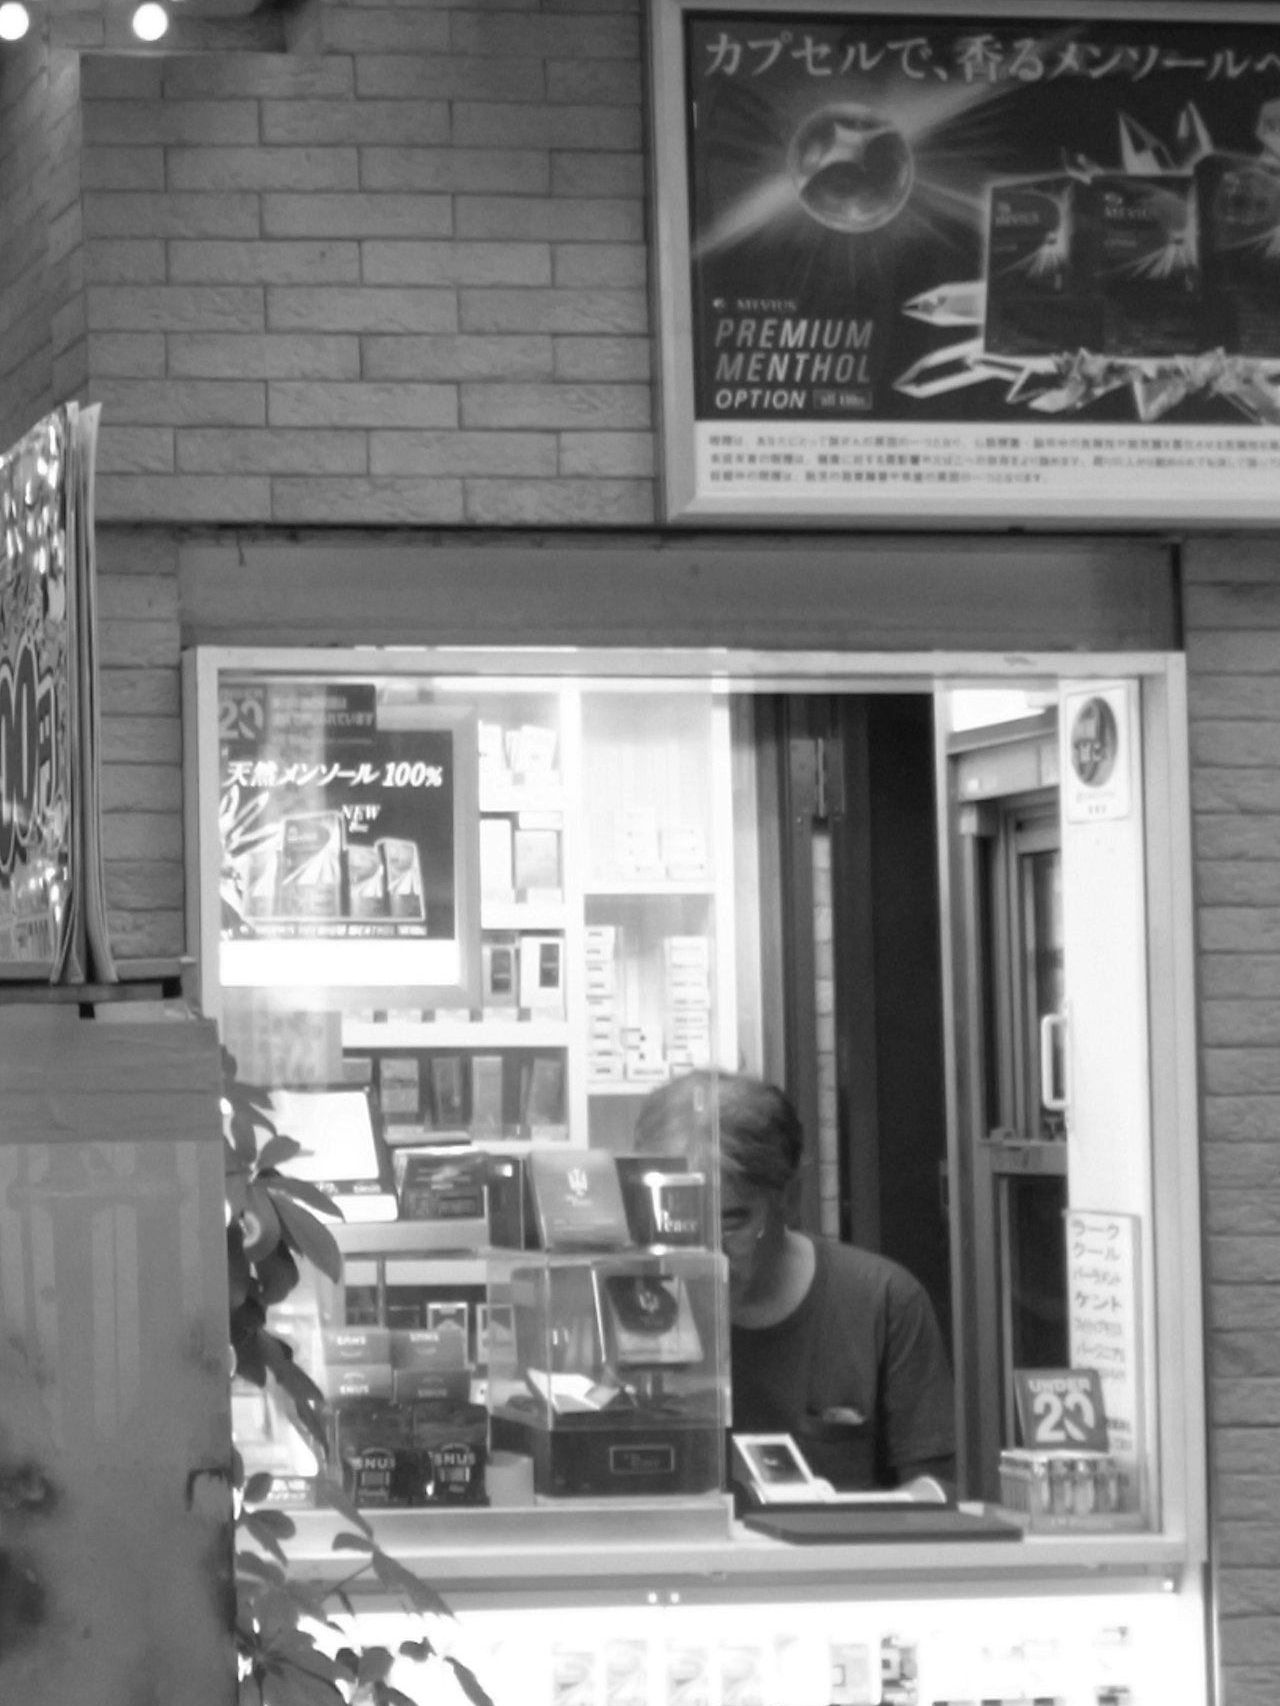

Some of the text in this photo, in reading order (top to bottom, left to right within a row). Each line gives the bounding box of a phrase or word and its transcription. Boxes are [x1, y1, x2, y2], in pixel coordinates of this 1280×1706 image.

[715, 318, 875, 349] PREMIUM
[715, 352, 872, 383] MENTHOL
[714, 388, 807, 410] OPTION
[221, 758, 444, 788] 天然メンソール 100%
